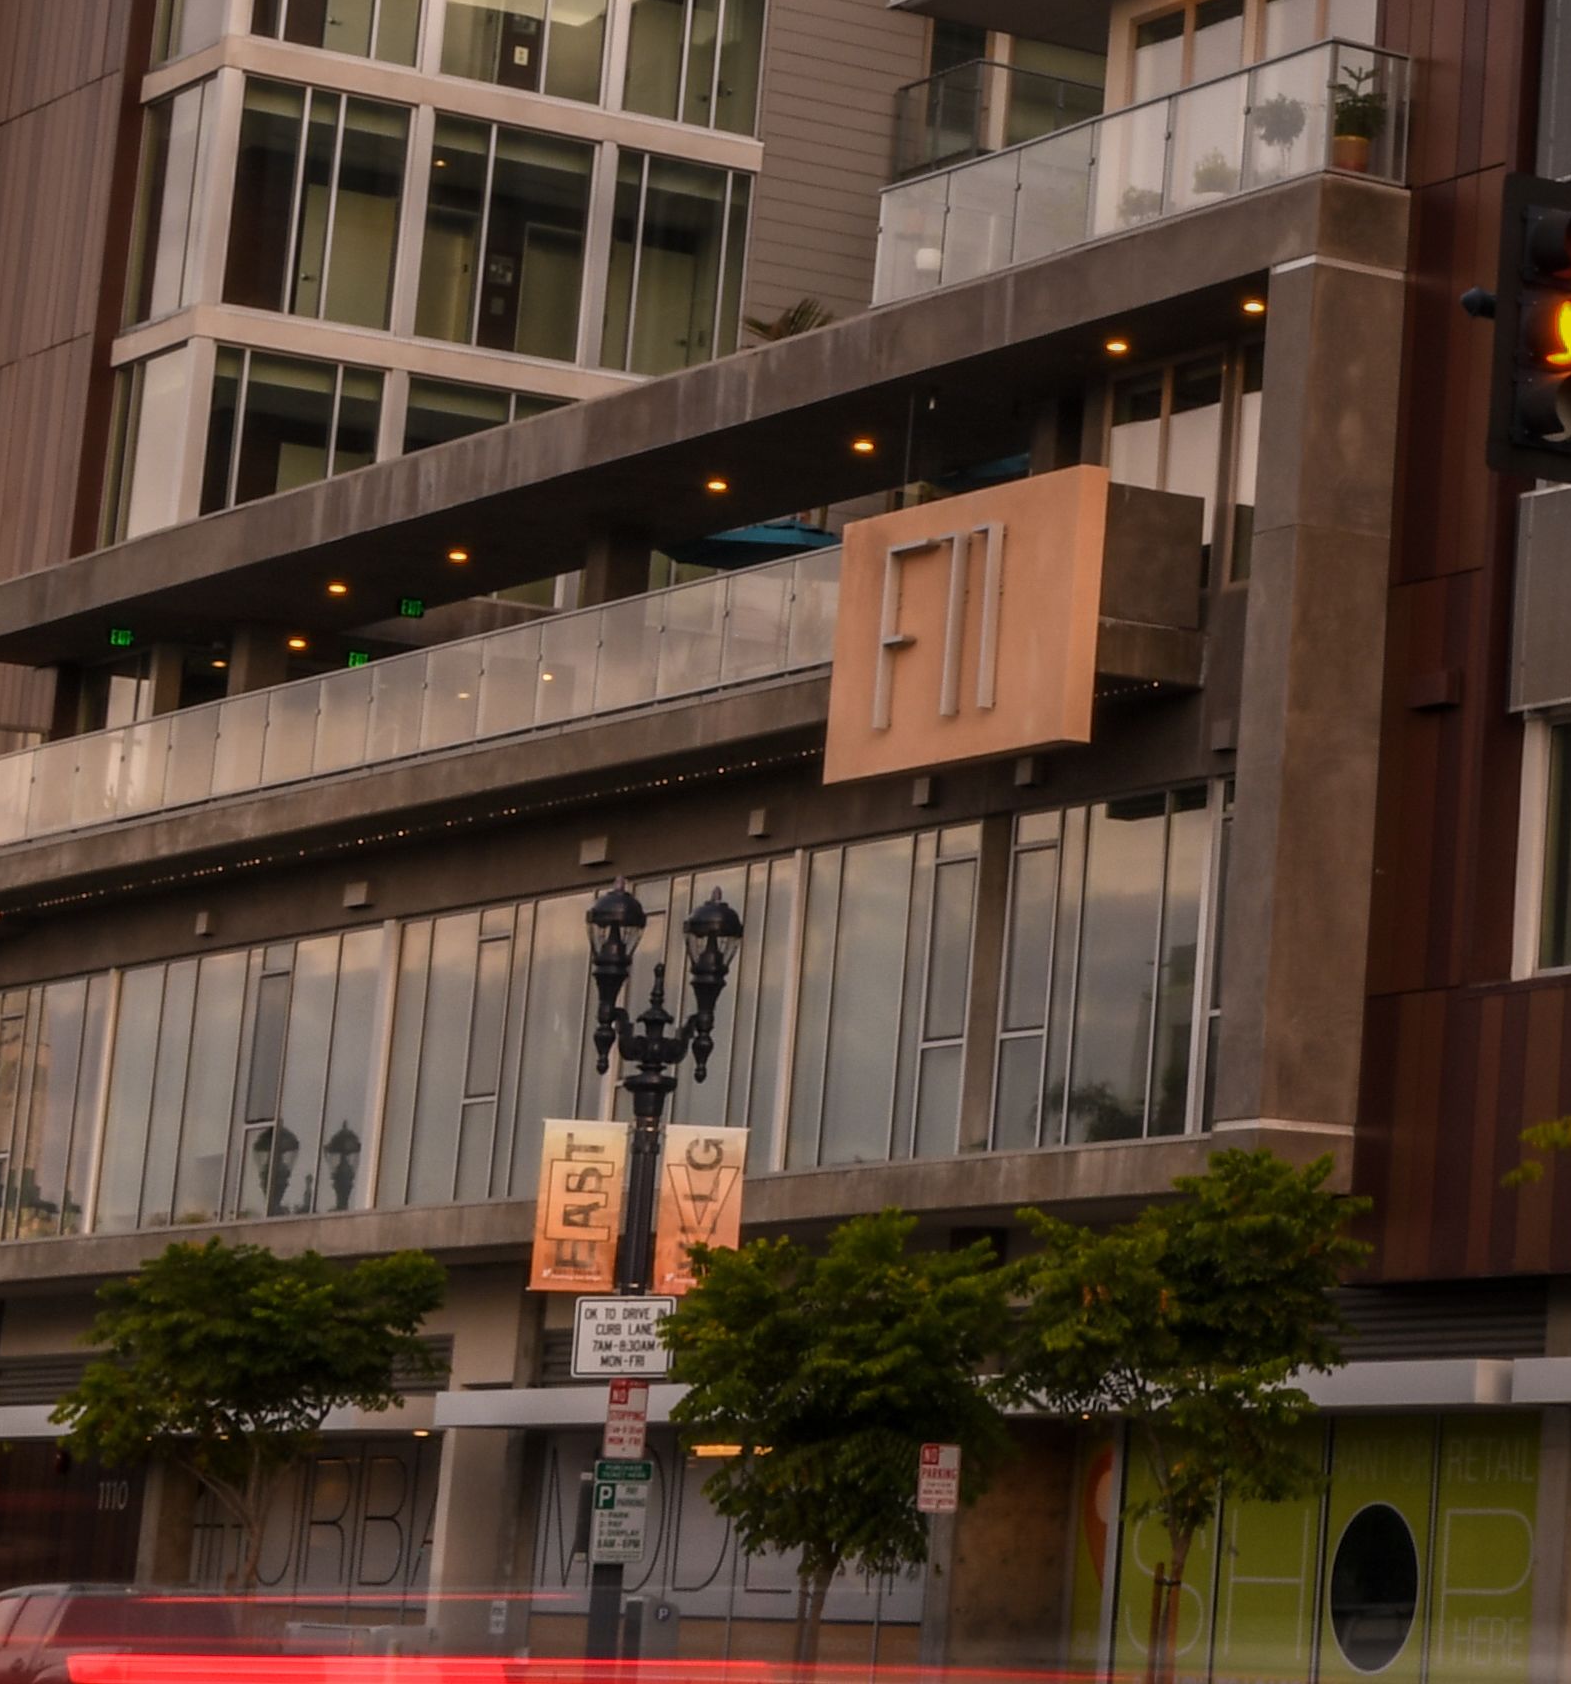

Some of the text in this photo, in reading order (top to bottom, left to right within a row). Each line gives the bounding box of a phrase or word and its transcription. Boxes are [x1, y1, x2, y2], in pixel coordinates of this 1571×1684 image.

[584, 1307, 668, 1320] OK TO DRIVE IN
[595, 1323, 654, 1335] CURB LANE
[600, 1355, 645, 1367] MON-FRI
[98, 1481, 127, 1510] 1110
[598, 1485, 613, 1507] P
[1125, 1501, 1534, 1675] SHOP
